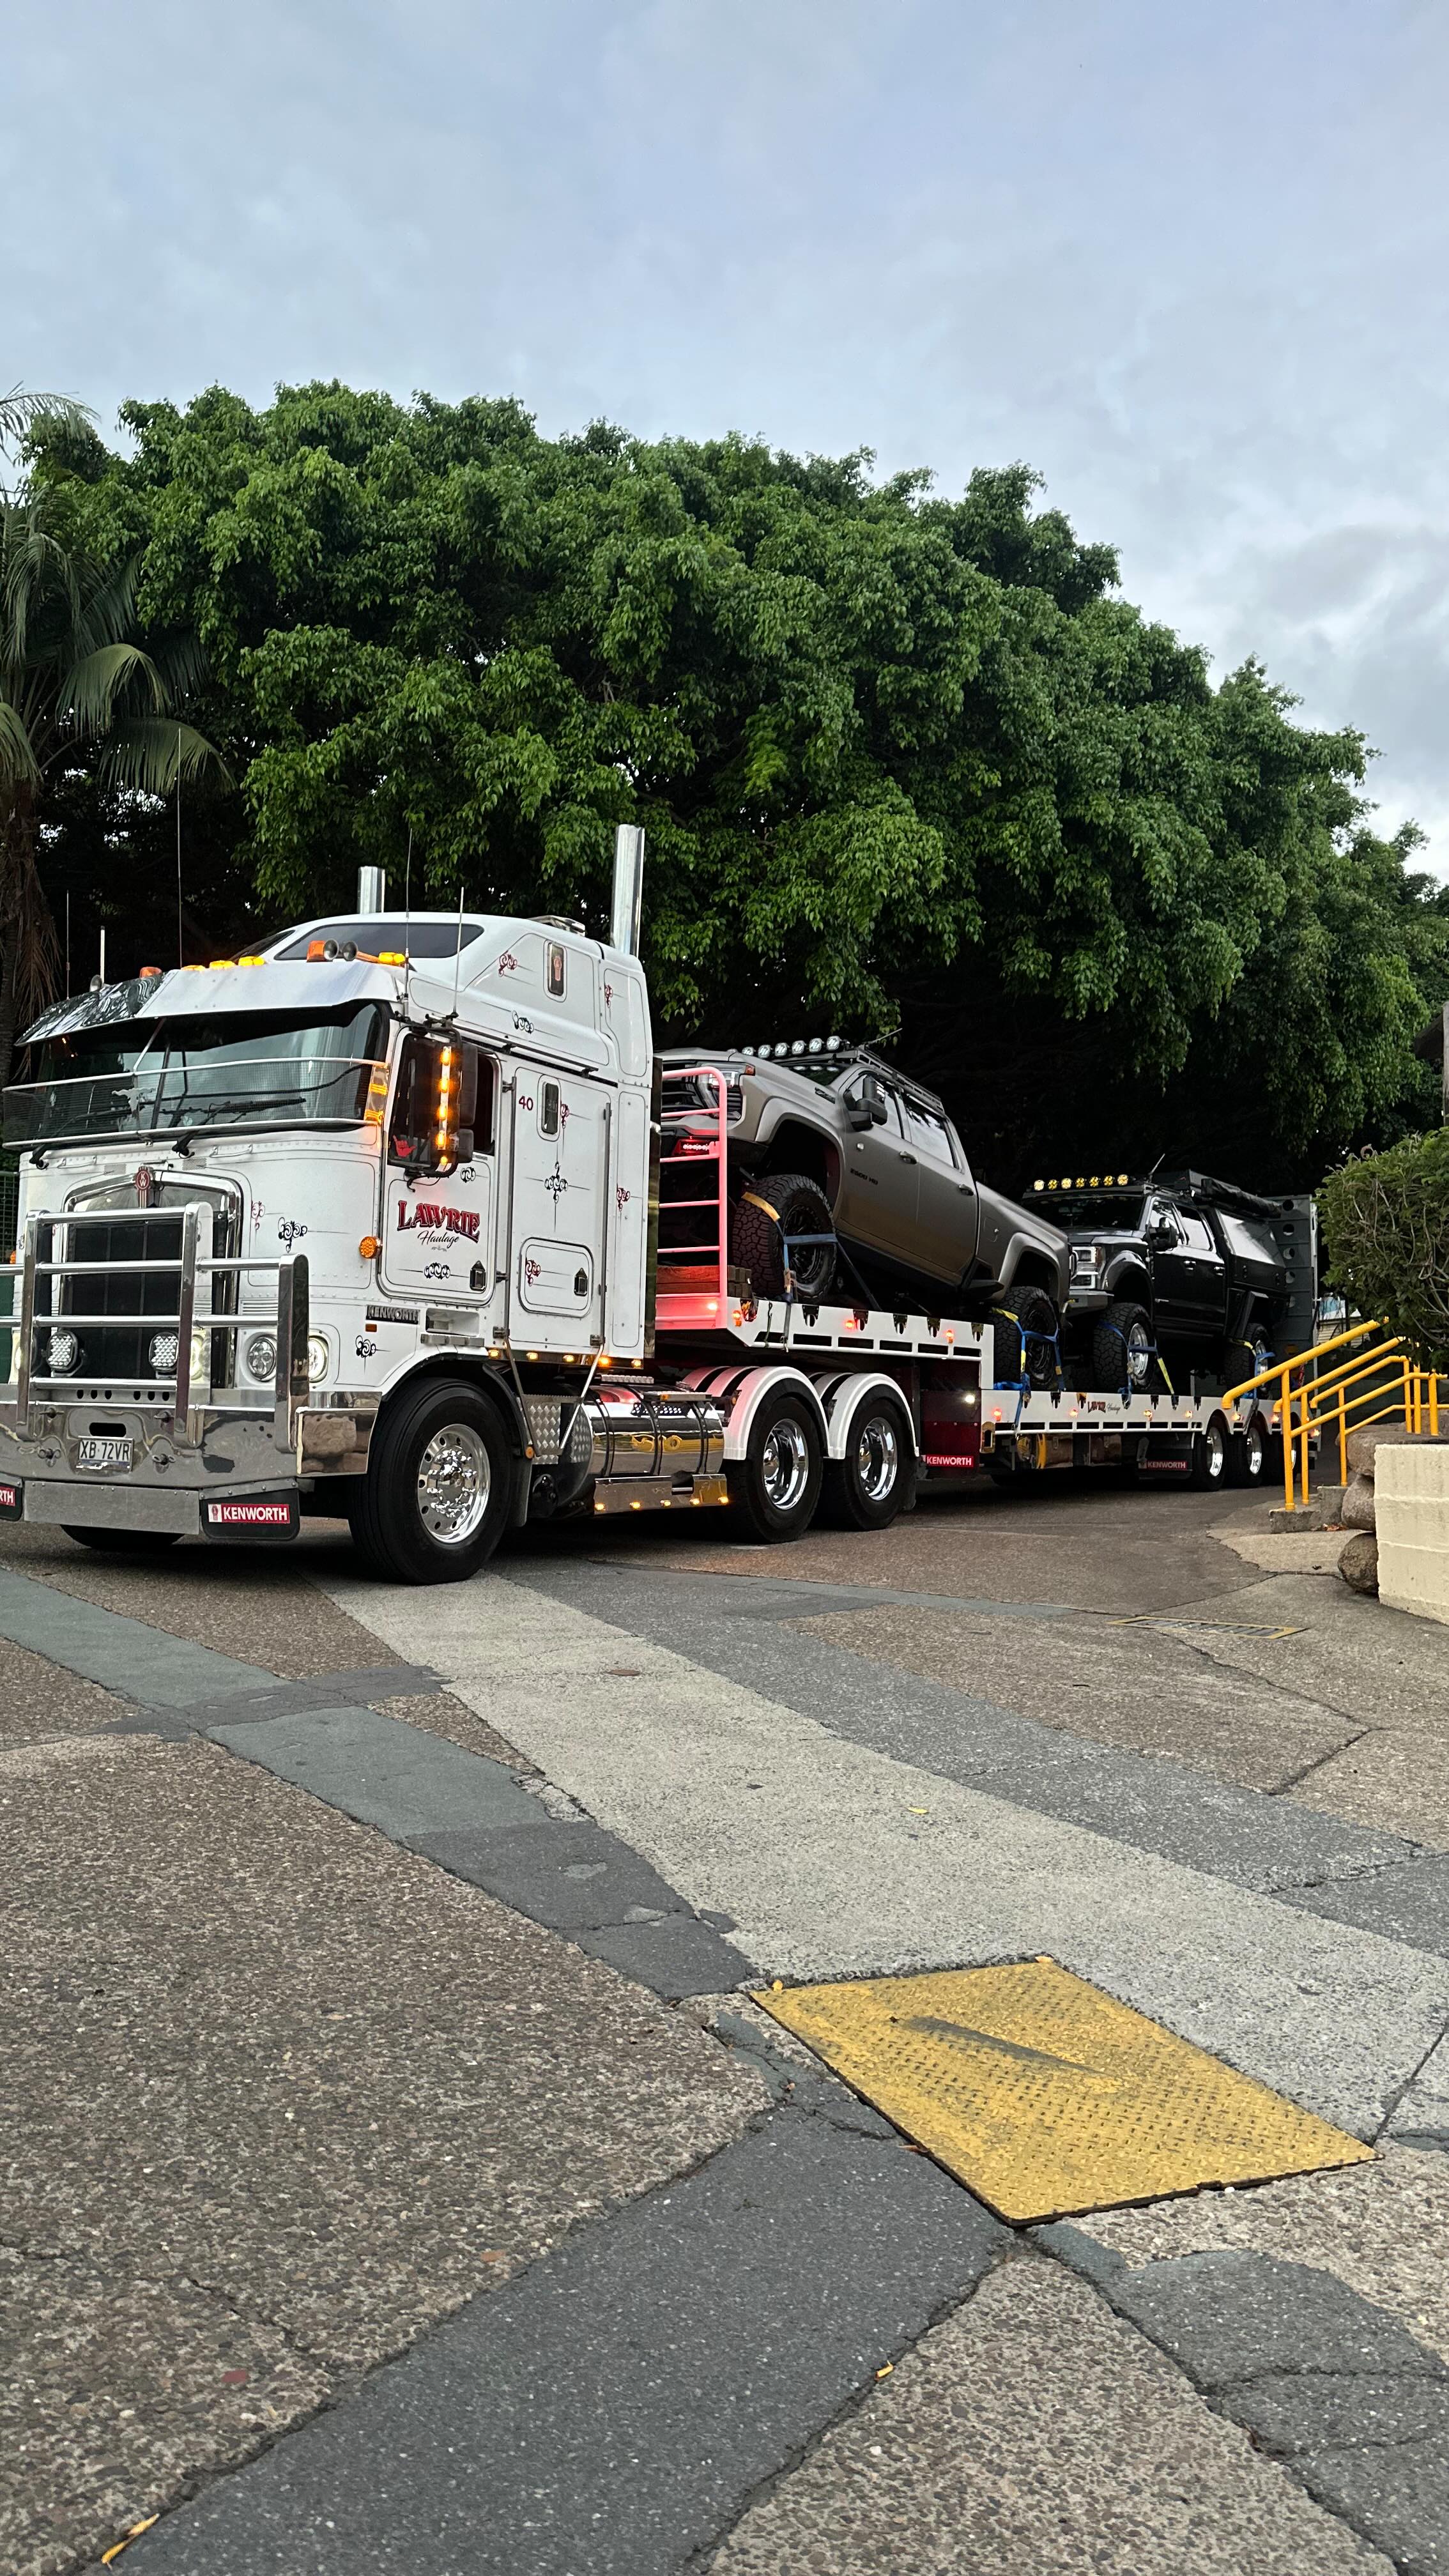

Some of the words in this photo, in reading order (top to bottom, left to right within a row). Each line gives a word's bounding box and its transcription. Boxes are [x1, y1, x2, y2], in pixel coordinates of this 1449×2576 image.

[518, 1095, 533, 1110] 40
[397, 1200, 480, 1243] LAWRIE
[417, 1230, 459, 1248] Haulage
[367, 1305, 420, 1321] KENWORTH
[926, 1456, 972, 1466] KENWORTH
[223, 1506, 288, 1521] KENWORTH
